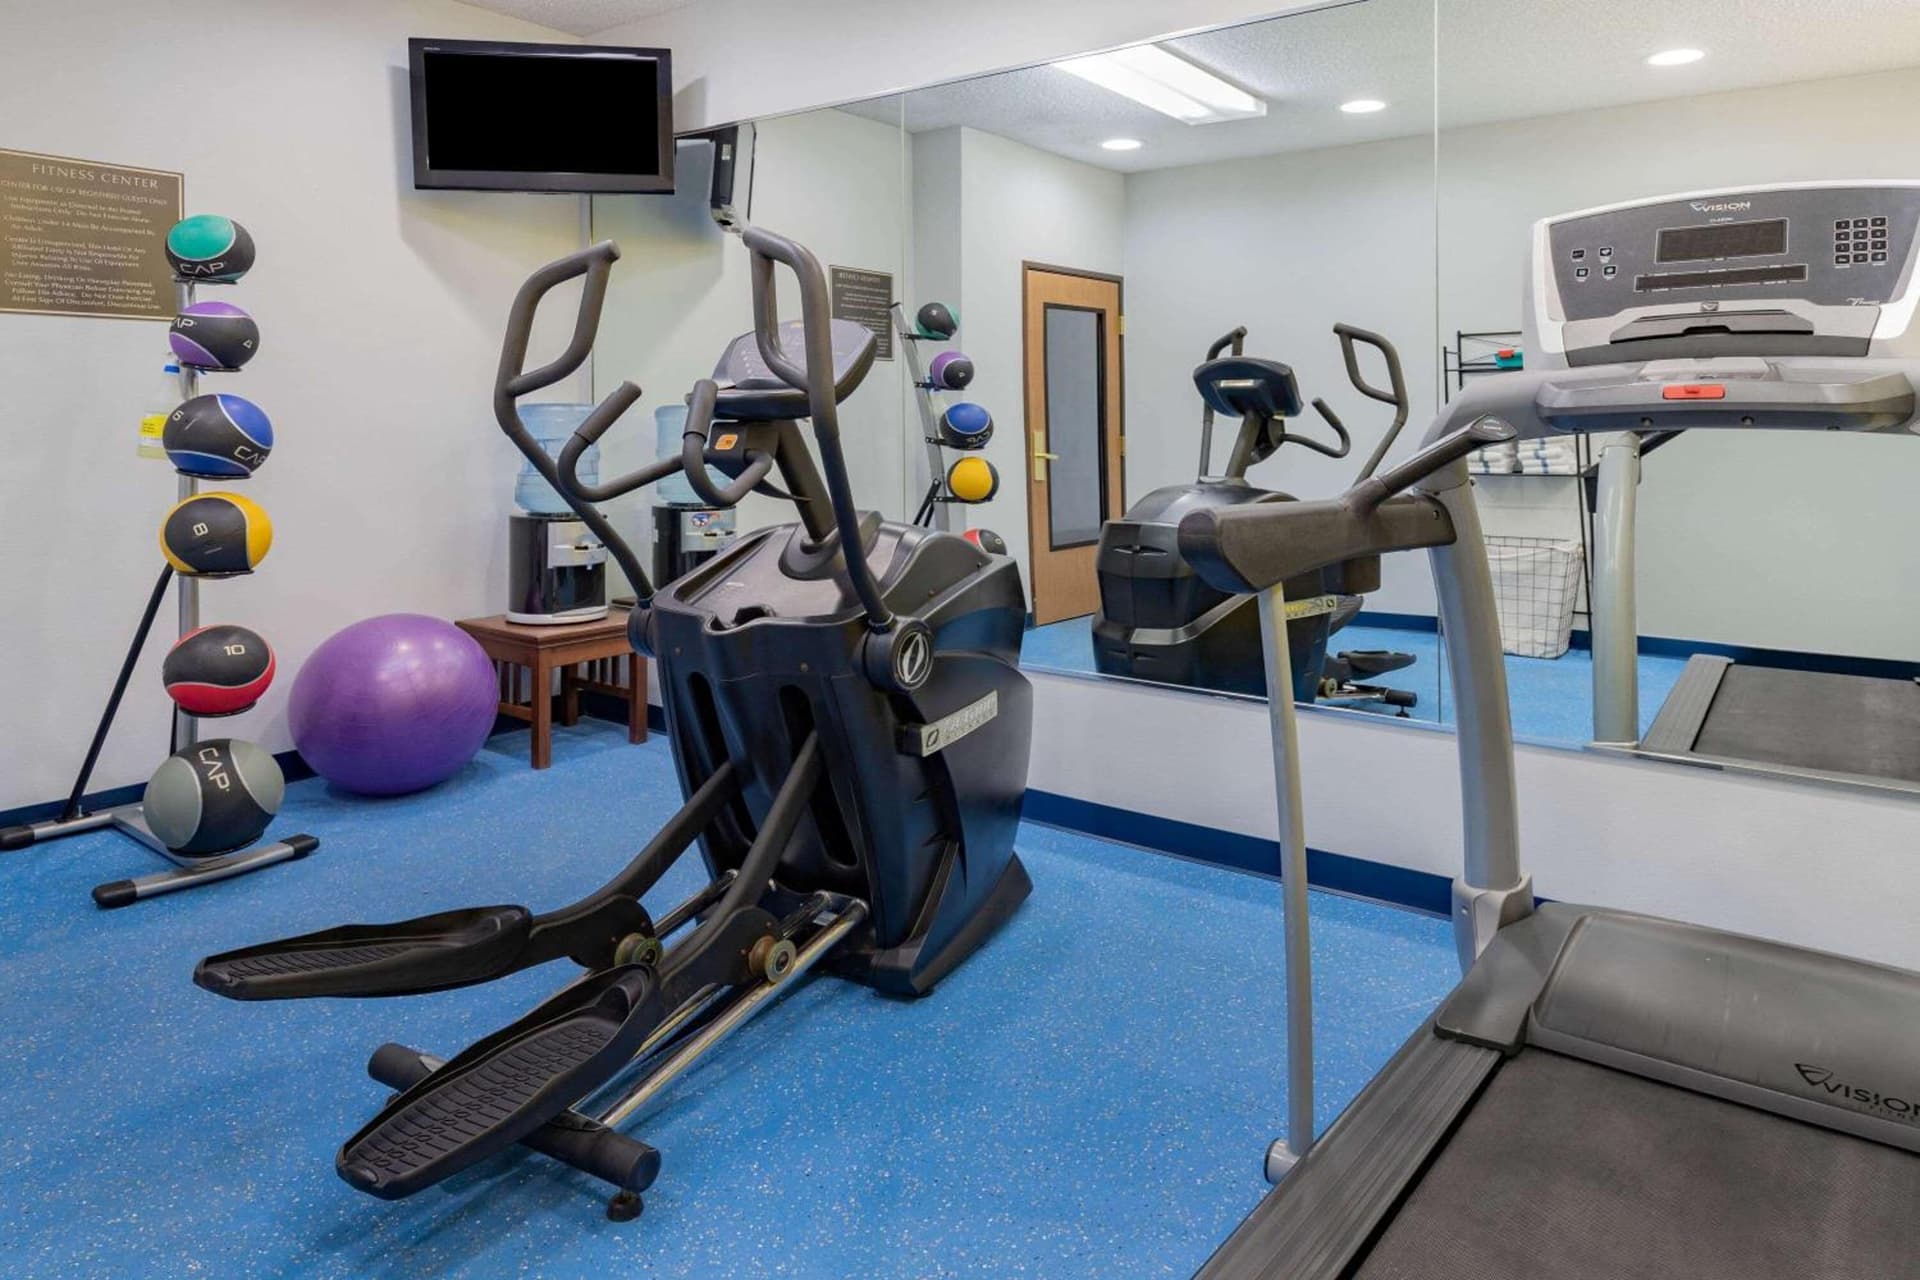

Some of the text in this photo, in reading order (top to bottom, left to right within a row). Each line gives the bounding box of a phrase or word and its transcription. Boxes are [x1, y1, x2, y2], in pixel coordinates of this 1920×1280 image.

[32, 163, 158, 188] FITNESS CENTER
[1702, 201, 1750, 212] VISION
[180, 262, 224, 275] CAP
[173, 318, 194, 329] AP
[243, 339, 253, 349] 4
[172, 410, 184, 421] 6
[233, 445, 267, 465] CAP
[193, 522, 209, 537] 8
[224, 644, 245, 656] 10
[198, 747, 229, 791] CAP
